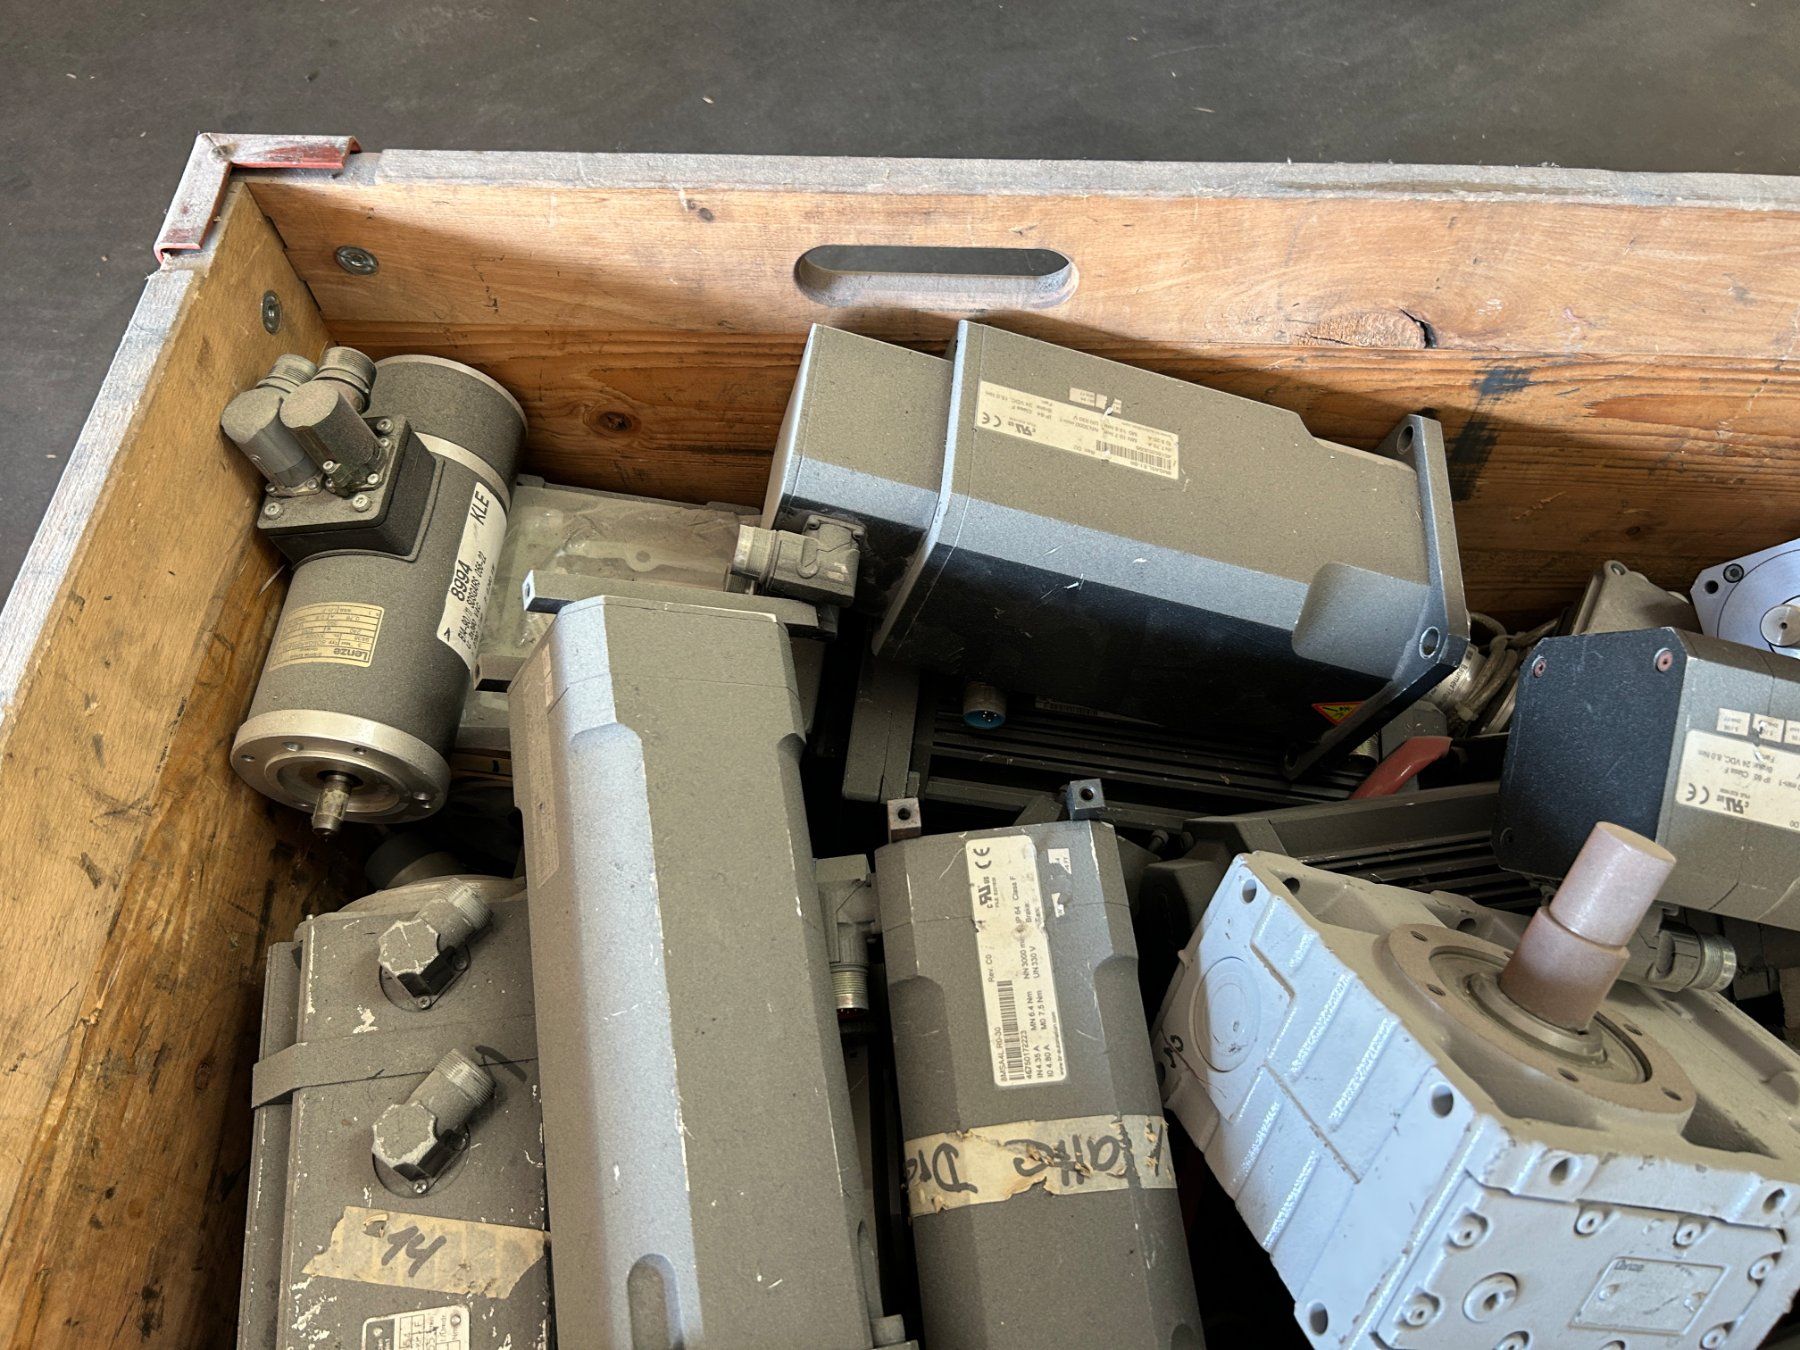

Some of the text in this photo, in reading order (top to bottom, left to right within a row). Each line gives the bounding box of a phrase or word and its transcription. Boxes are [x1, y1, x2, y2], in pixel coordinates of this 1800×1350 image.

[470, 490, 489, 526] KLE
[450, 559, 473, 602] 8994
[333, 648, 368, 660] Lenze
[1010, 881, 1019, 900] Class
[1031, 966, 1039, 978] UN
[1025, 990, 1033, 1003] Nm
[1035, 989, 1043, 1002] Nm
[1029, 1017, 1037, 1030] MN
[1039, 1018, 1047, 1029] M0
[381, 1225, 447, 1278] 14
